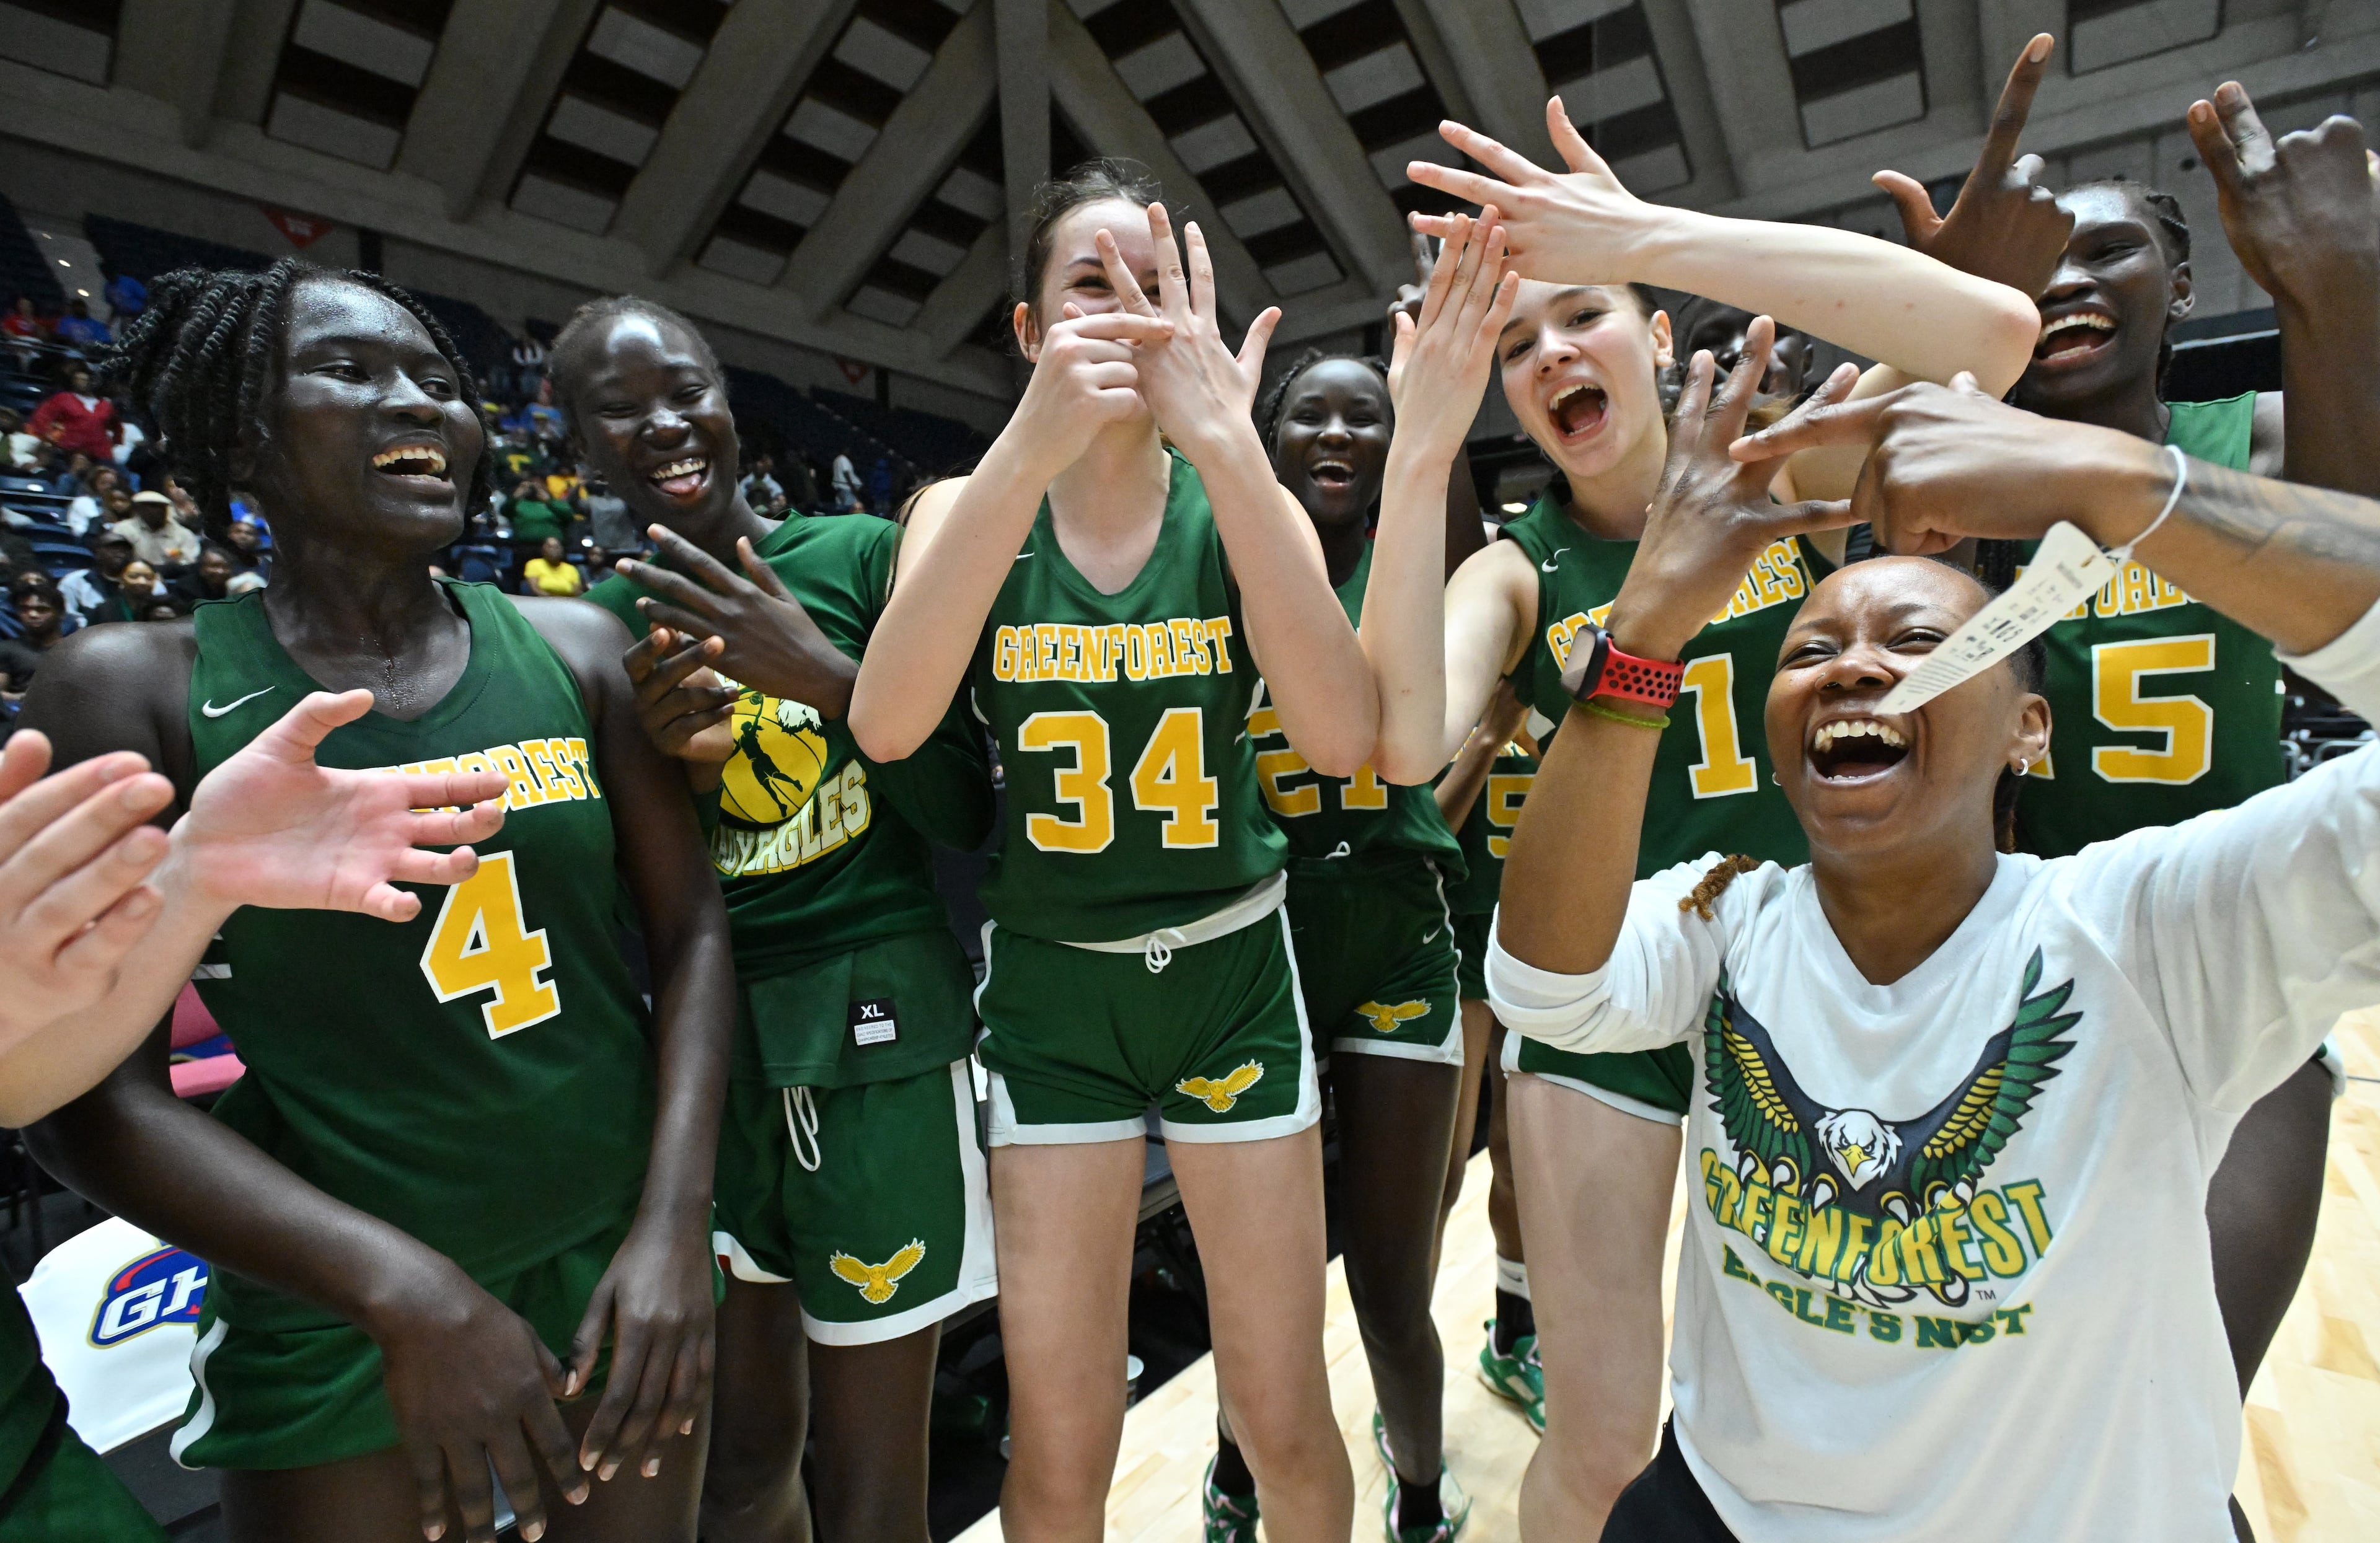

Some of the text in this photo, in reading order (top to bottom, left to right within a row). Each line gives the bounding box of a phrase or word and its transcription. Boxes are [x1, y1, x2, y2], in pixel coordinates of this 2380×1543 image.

[992, 615, 1233, 683] GREENFOREST
[2030, 633, 2216, 785] 5
[1018, 707, 1219, 854] 34
[1680, 653, 1758, 799] 1
[743, 758, 871, 876] EAGLES
[420, 850, 562, 1040] 4
[860, 1004, 884, 1019] XL
[1700, 1148, 2055, 1286] GREENFOREST
[1722, 1242, 1903, 1345] EGLE'S
[1975, 1290, 1997, 1301] TM
